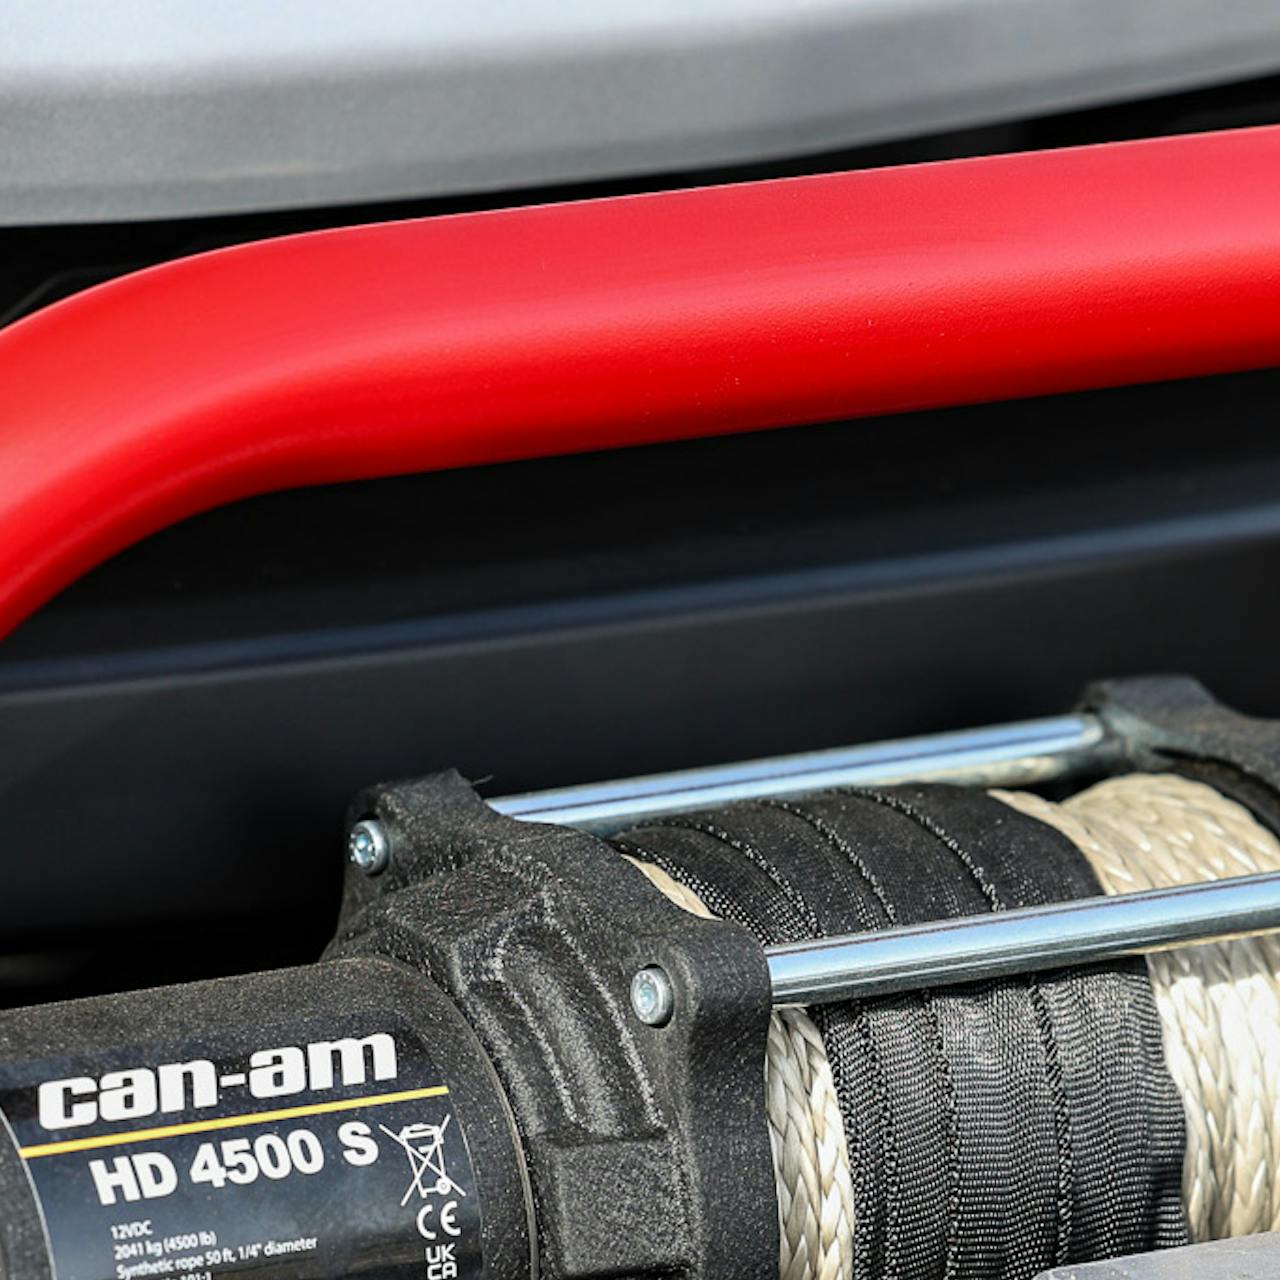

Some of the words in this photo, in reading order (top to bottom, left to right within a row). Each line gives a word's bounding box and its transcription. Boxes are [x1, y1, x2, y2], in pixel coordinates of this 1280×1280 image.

[38, 1032, 398, 1131] can-am
[89, 1150, 178, 1207] HD
[189, 1129, 325, 1188] 4500
[337, 1121, 379, 1166] S
[110, 1220, 153, 1240] 12VDC
[114, 1242, 144, 1260] 2041
[145, 1240, 163, 1257] kg
[163, 1232, 198, 1254] (4500
[198, 1230, 218, 1247] lb)
[174, 1255, 204, 1272] rope
[205, 1249, 221, 1266] 50
[264, 1237, 318, 1257] diameter
[425, 1243, 456, 1263] UK
